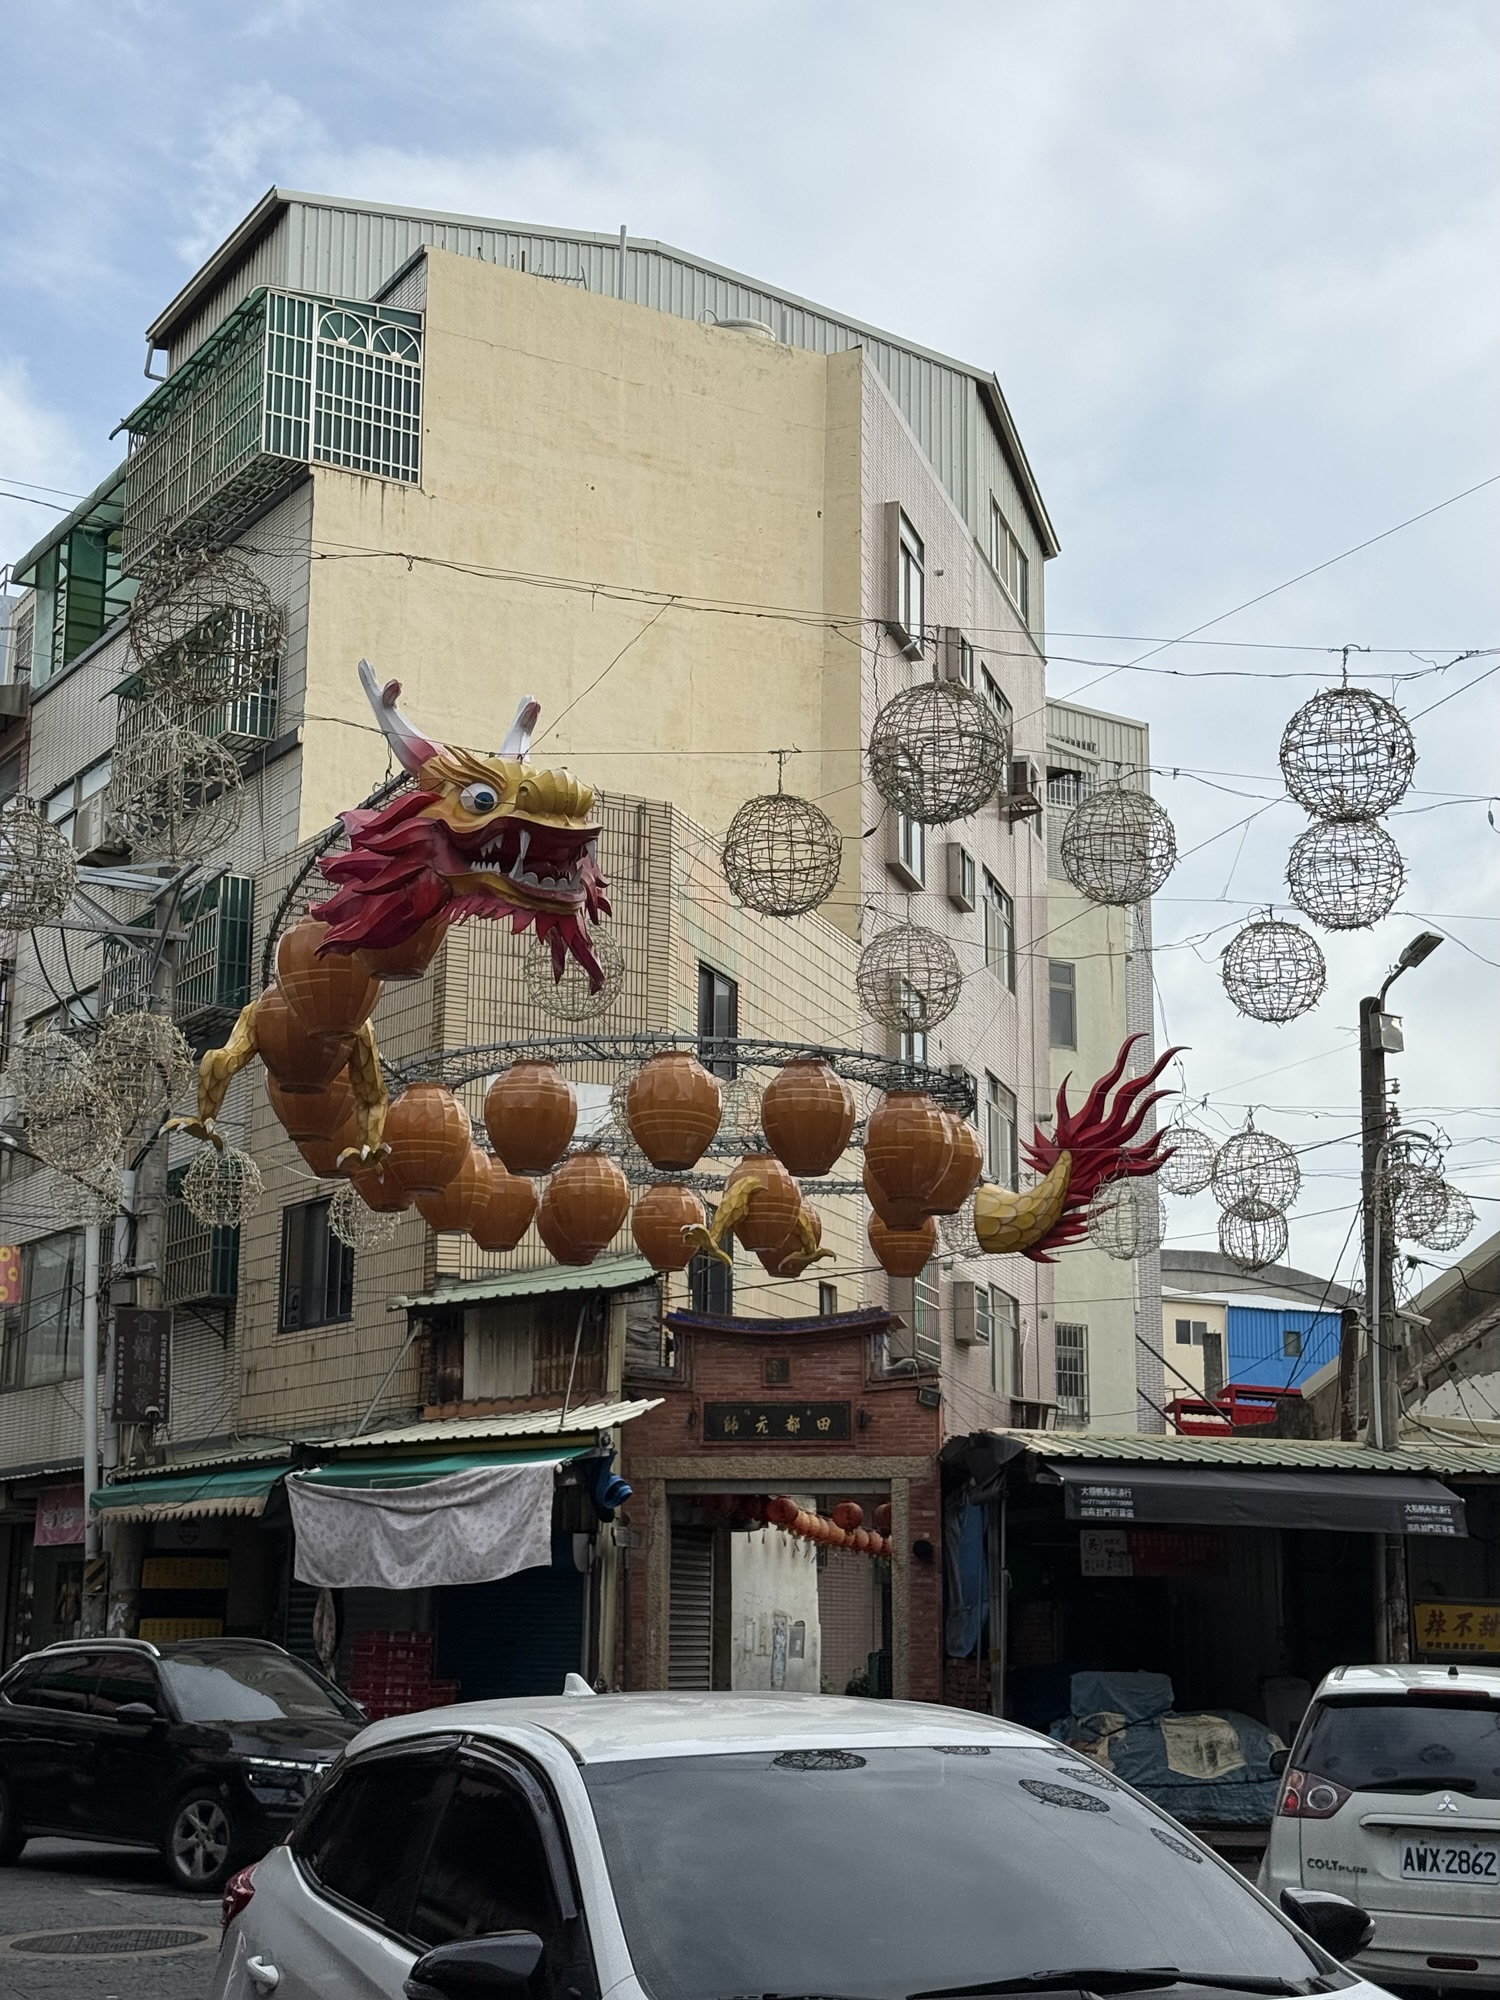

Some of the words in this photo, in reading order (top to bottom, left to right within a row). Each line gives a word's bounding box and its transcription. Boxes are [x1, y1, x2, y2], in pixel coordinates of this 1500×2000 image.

[132, 1334, 157, 1415] 龍山寺
[1307, 1857, 1339, 1871] COLT
